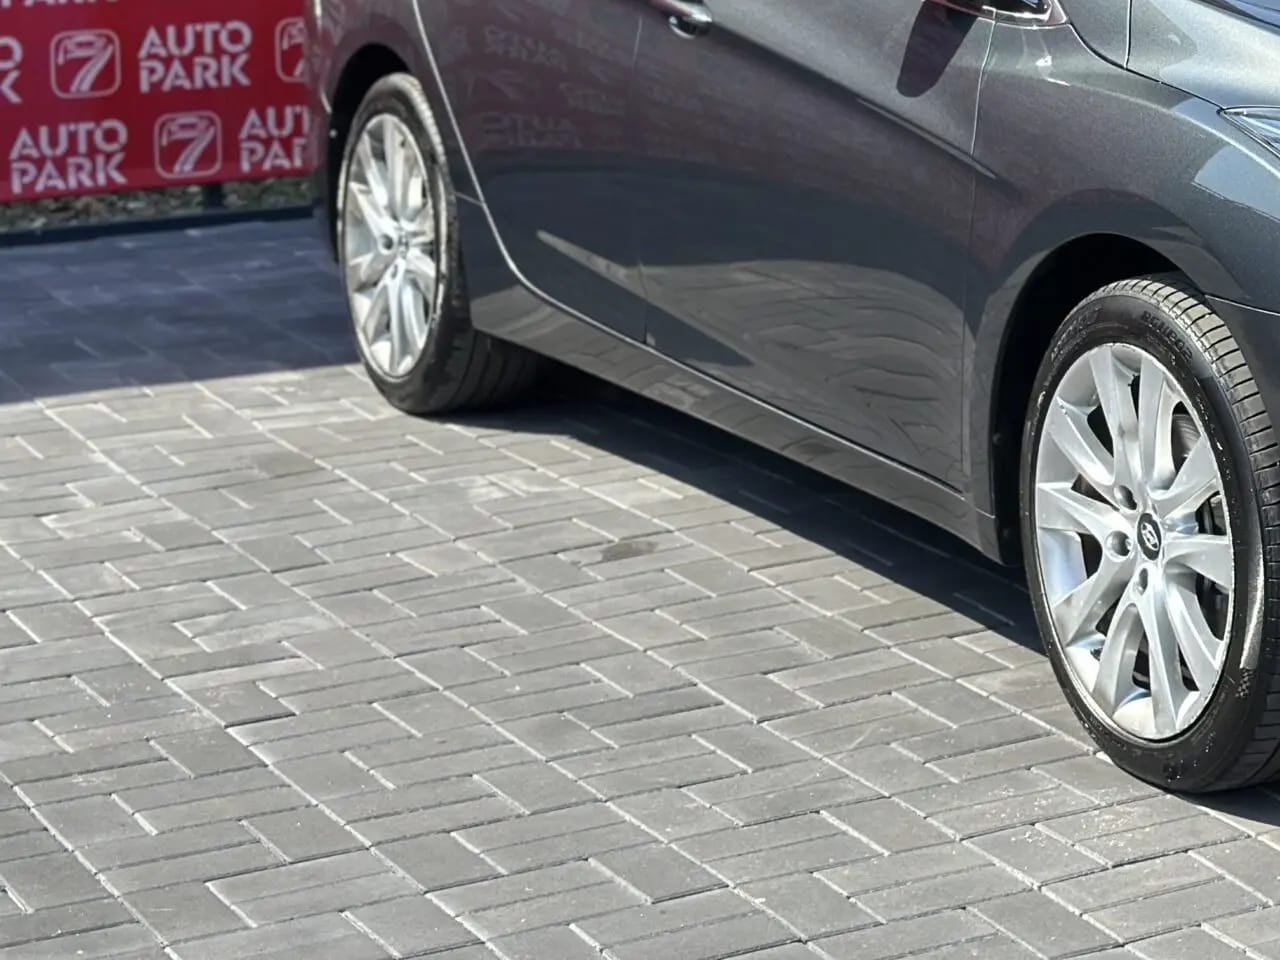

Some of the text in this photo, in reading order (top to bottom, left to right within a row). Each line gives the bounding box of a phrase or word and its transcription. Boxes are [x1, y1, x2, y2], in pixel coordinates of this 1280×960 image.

[138, 21, 252, 57] AUTO
[139, 54, 251, 93] PARK
[10, 119, 128, 160] AUTO
[10, 153, 127, 194] PARK
